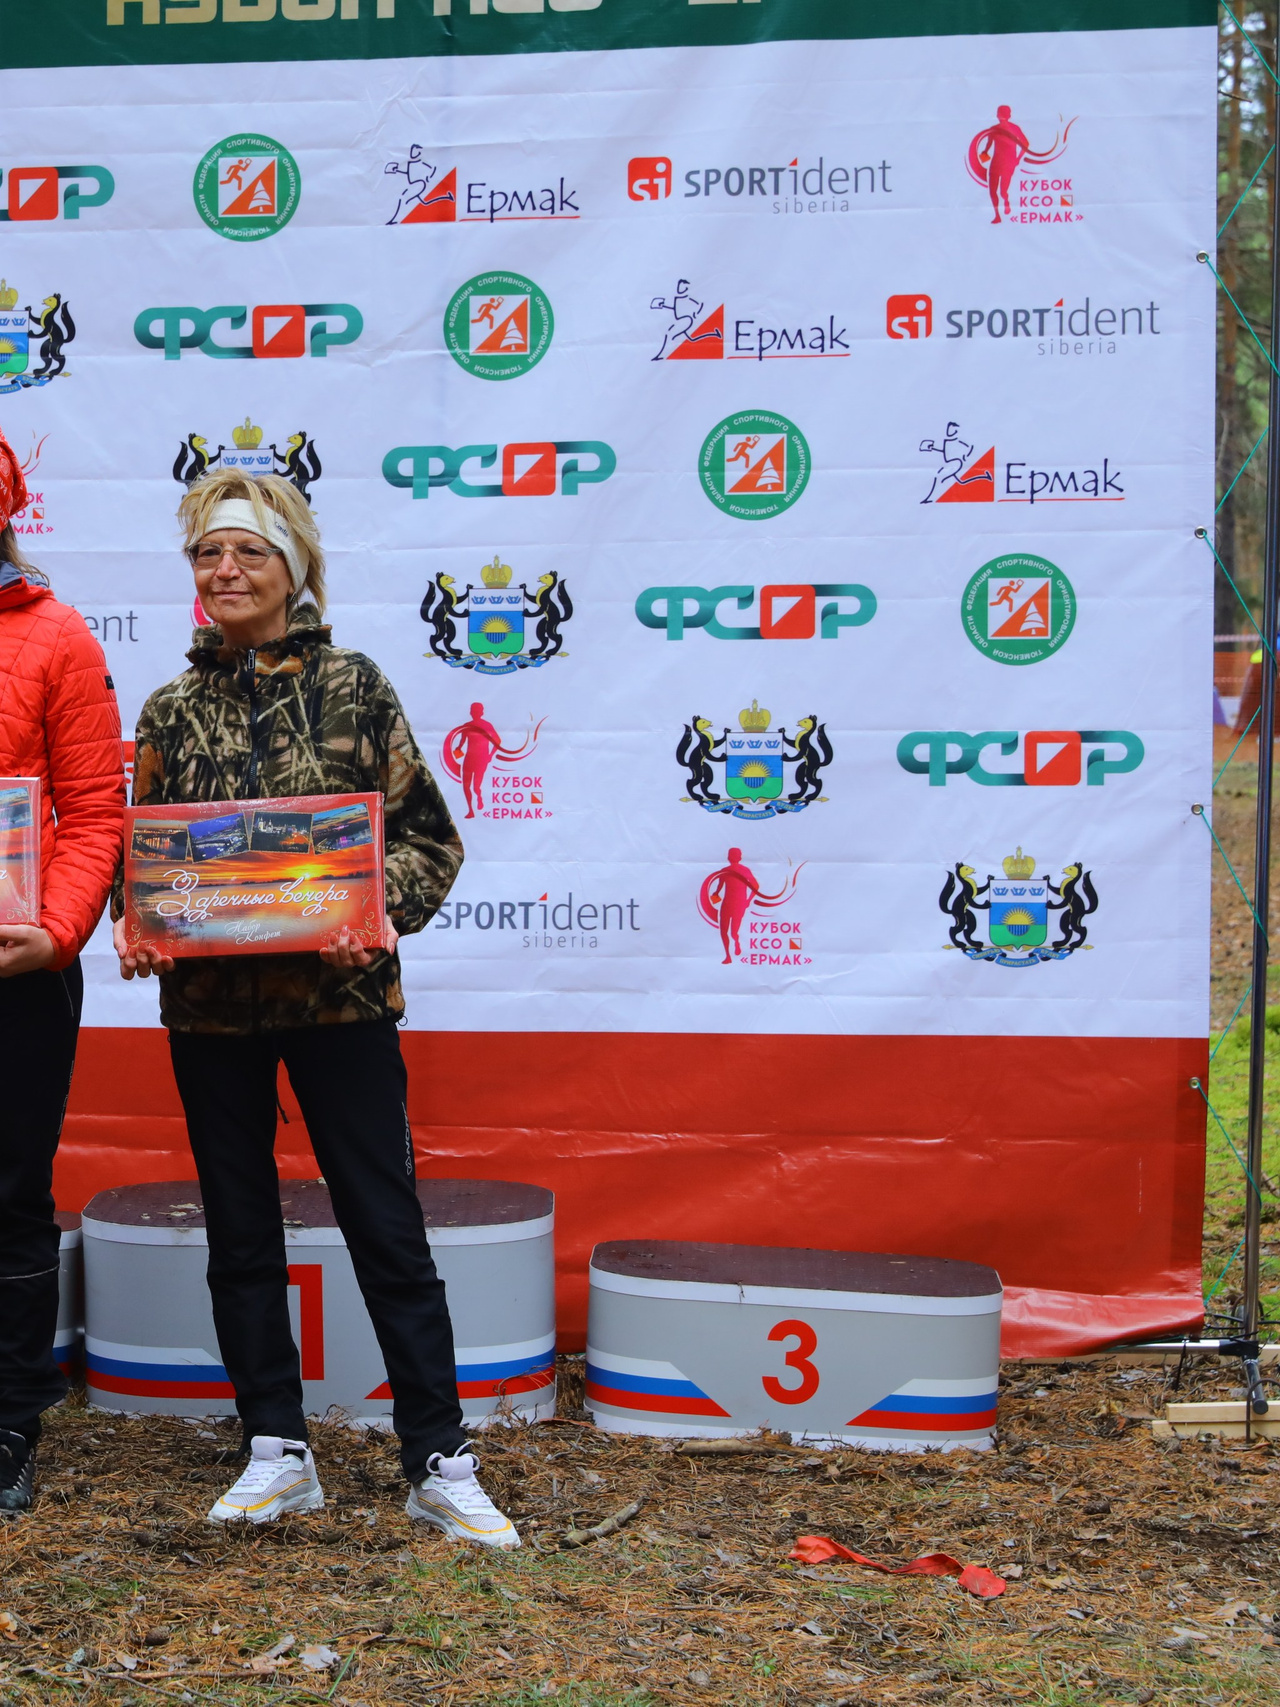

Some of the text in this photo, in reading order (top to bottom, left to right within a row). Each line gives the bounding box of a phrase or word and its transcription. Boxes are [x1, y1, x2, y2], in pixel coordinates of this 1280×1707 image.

[1020, 179, 1072, 192] КУБОК
[466, 177, 580, 223] Ермак
[773, 197, 849, 215] siberia
[1020, 196, 1053, 208] КСО
[1010, 210, 1084, 224] «ЕРМАК»
[734, 315, 851, 361] Ермак
[1037, 338, 1116, 356] siberia
[1006, 458, 1125, 504] Ермак
[13, 523, 54, 534] МАК»
[491, 776, 543, 789] КУБОК
[491, 791, 525, 804] КСО
[482, 806, 553, 820] «ЕРМАК»
[156, 869, 274, 923] Заречные
[750, 921, 802, 935] КУБОК
[523, 932, 598, 949] siberia
[750, 937, 783, 950] КСО
[739, 951, 812, 966] «ЕРМАК»
[287, 1264, 325, 1381] 1
[761, 1319, 820, 1406] 3
